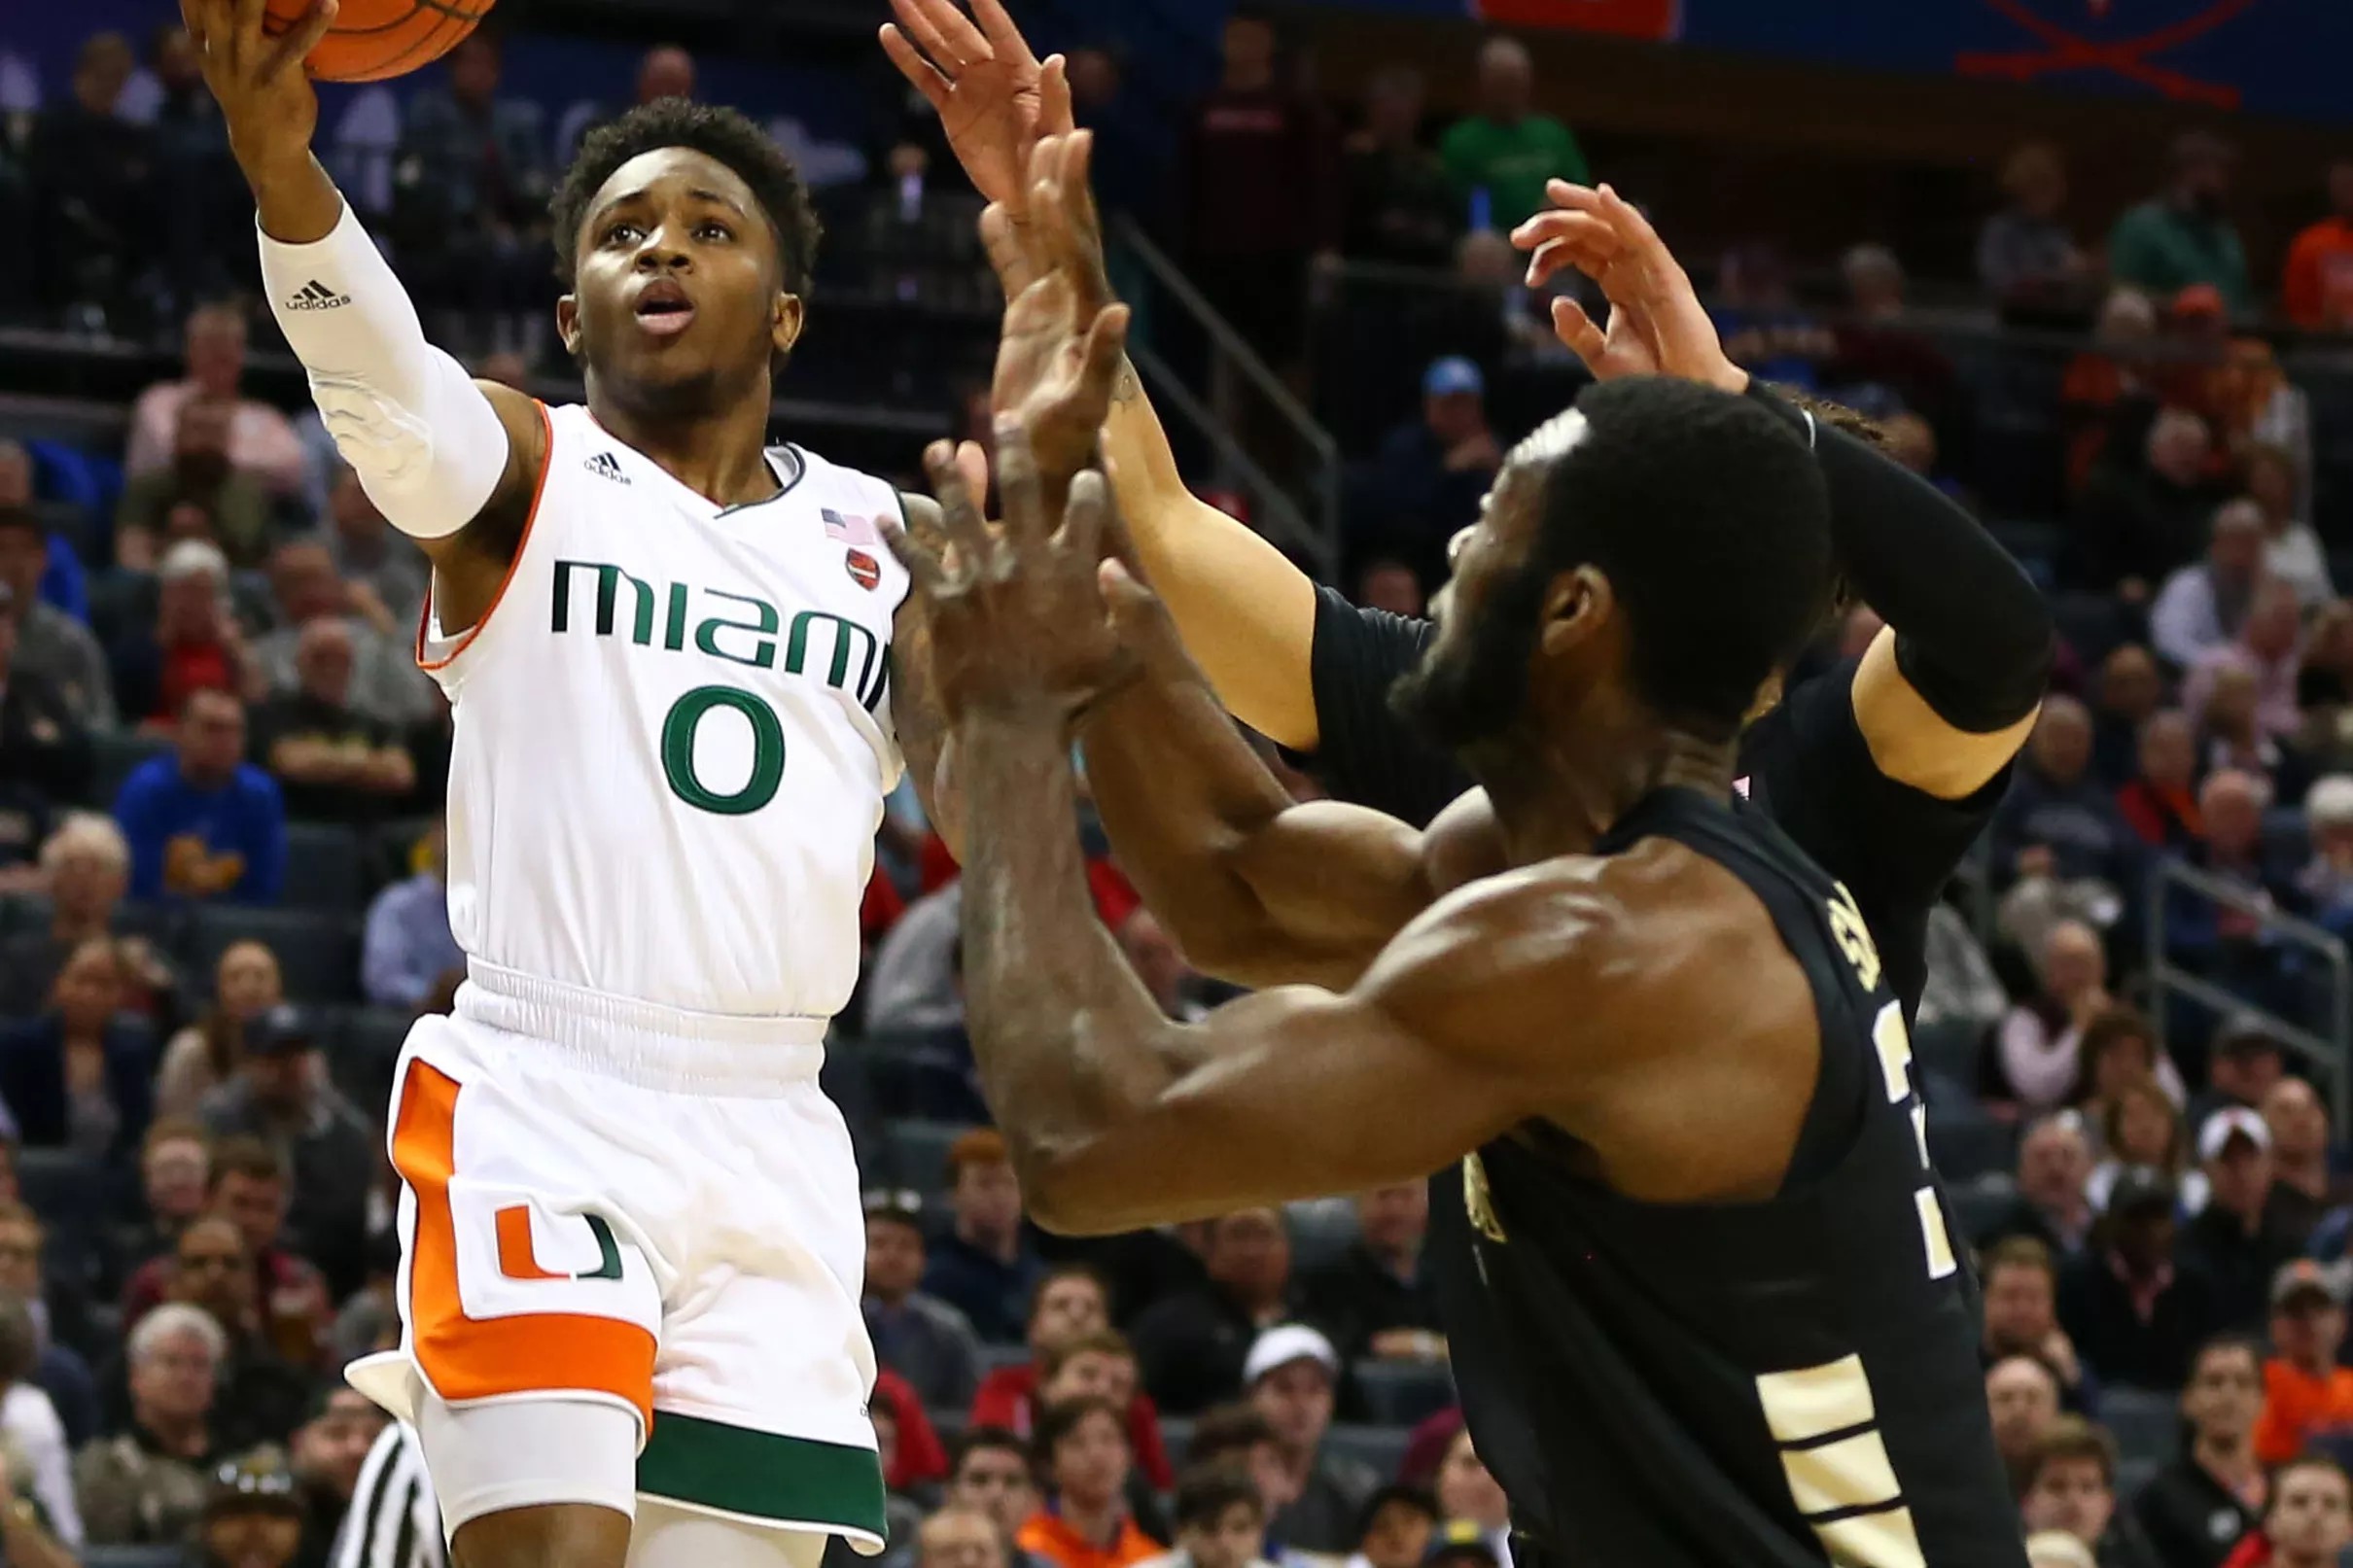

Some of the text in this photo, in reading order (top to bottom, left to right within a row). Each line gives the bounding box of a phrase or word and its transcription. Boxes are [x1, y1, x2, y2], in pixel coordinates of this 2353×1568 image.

[285, 295, 351, 310] adidas
[583, 460, 632, 486] adidas
[660, 684, 786, 816] 0
